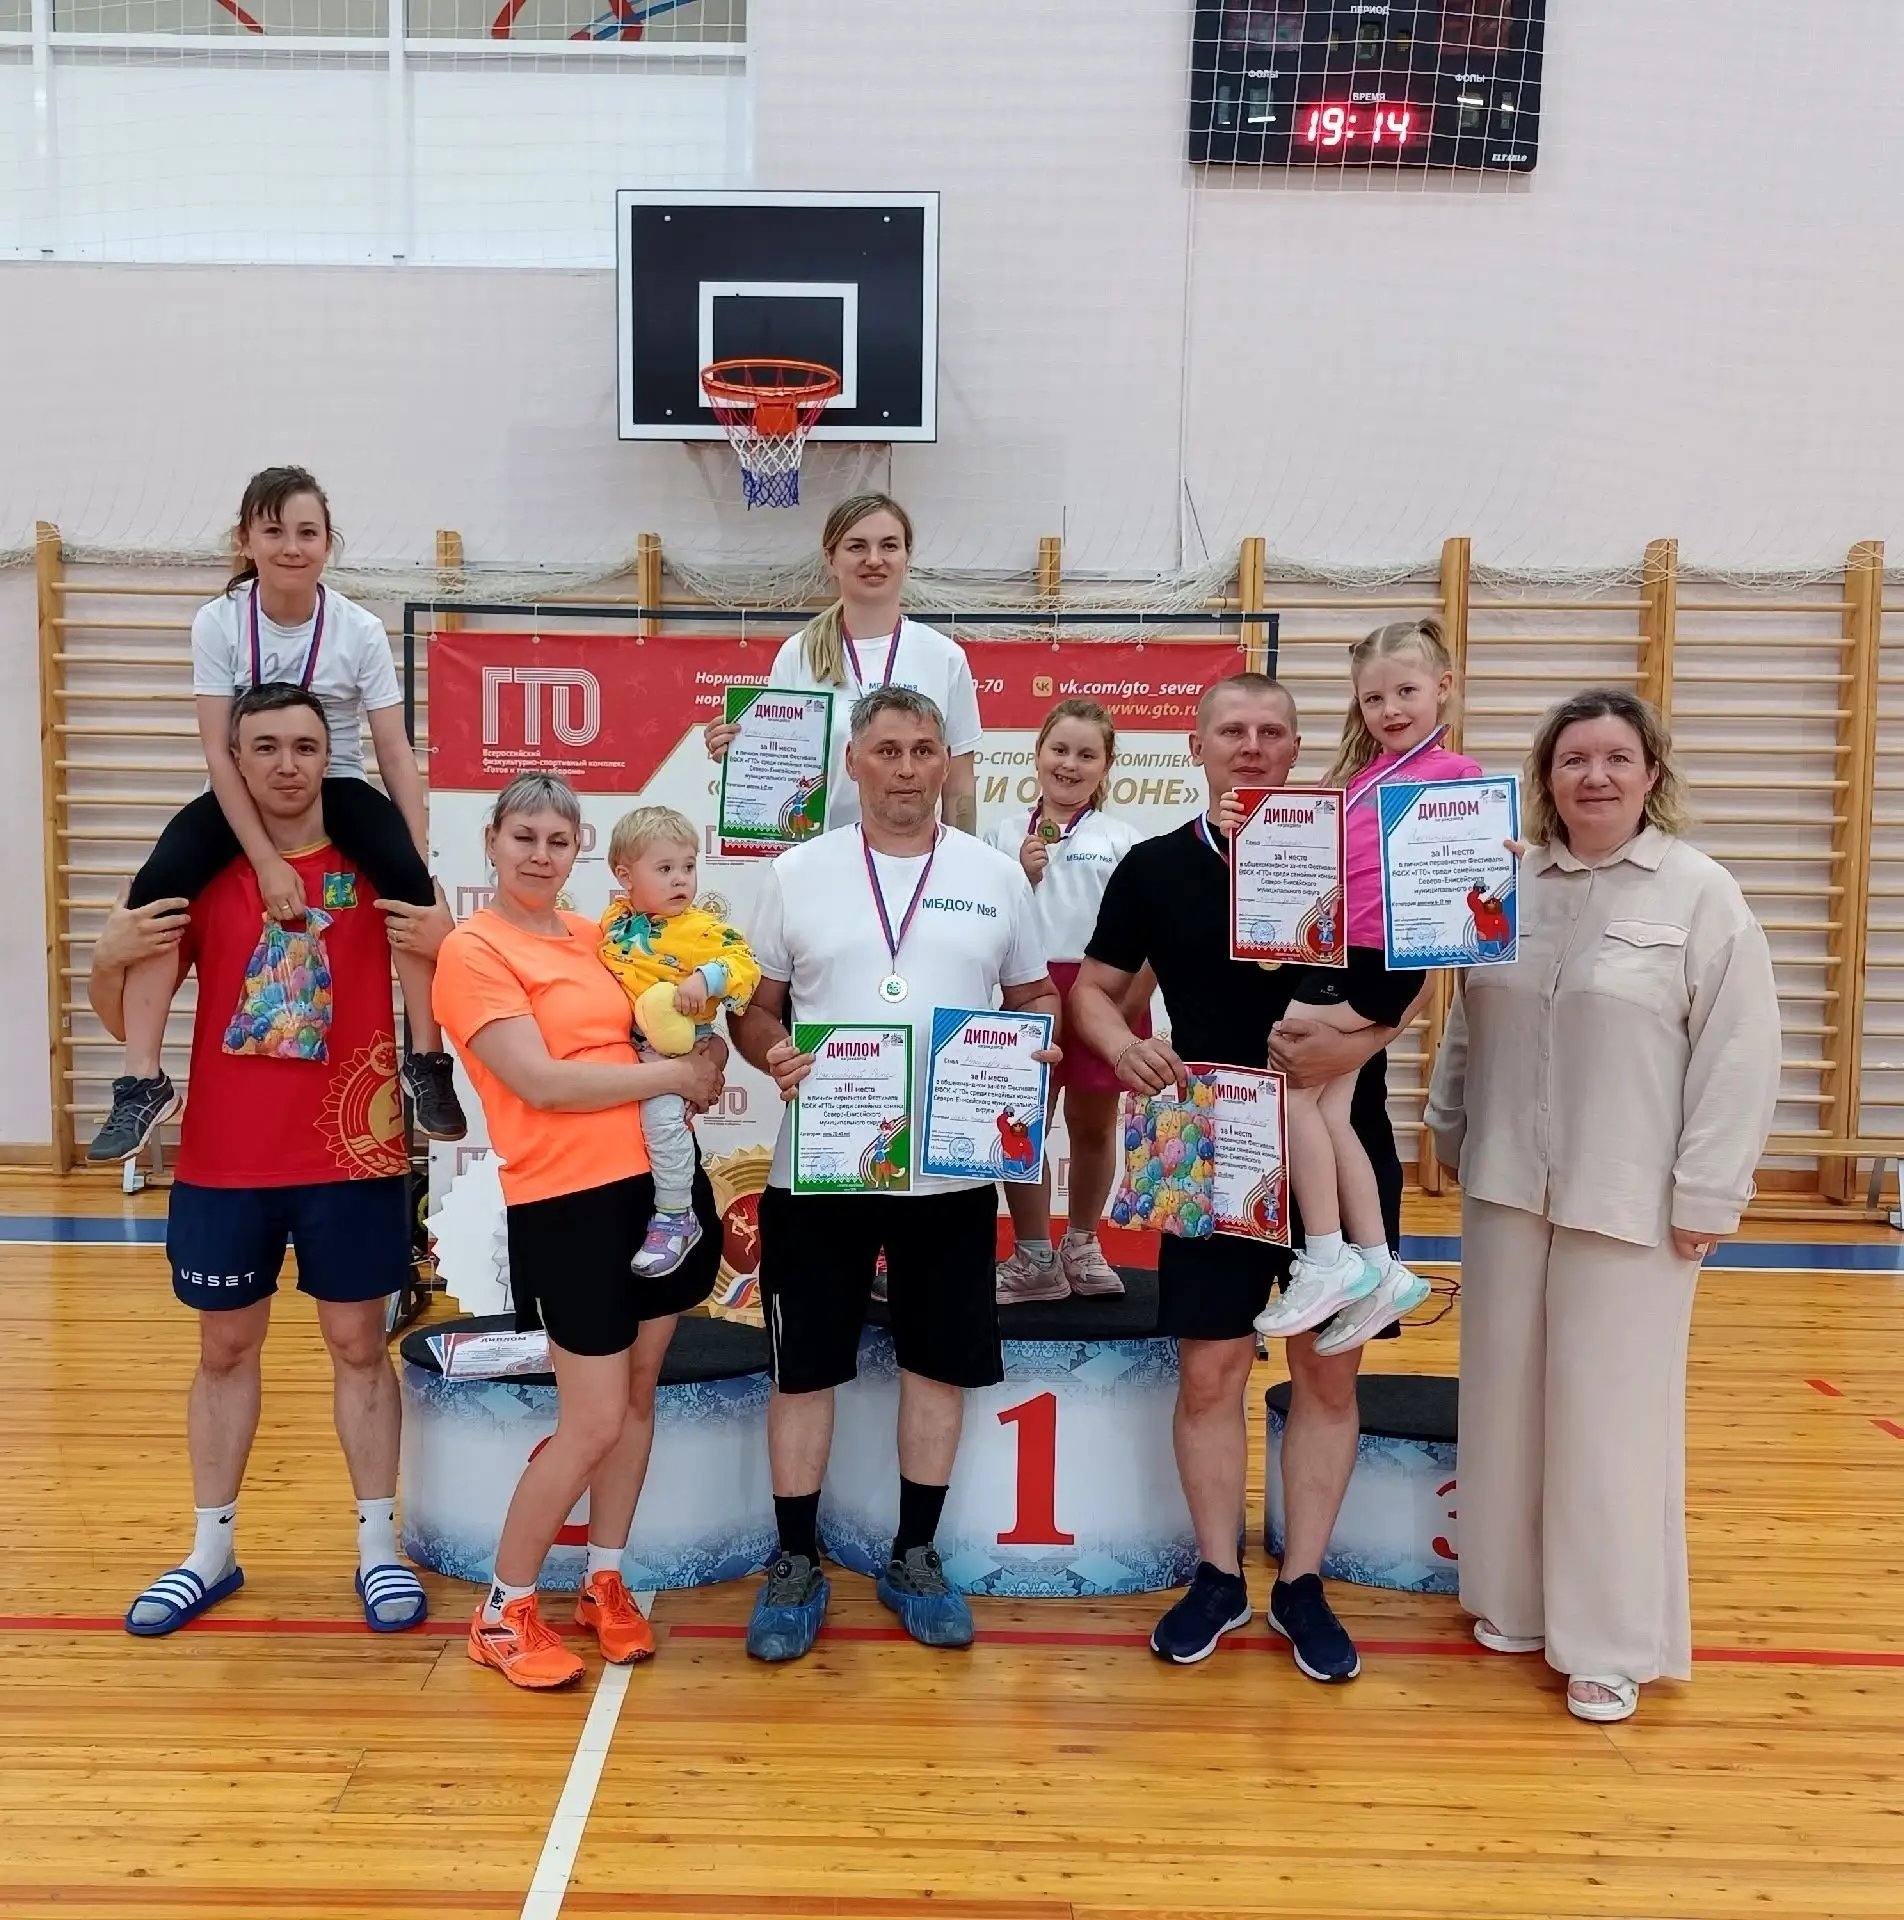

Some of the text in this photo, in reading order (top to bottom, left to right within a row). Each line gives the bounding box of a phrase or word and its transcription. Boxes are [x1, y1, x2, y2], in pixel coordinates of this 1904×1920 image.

[1350, 5, 1390, 16] ПЕРИОД
[1248, 70, 1279, 79] ФОЛЫ
[1455, 73, 1485, 84] ФОЛЫ
[1352, 92, 1386, 102] ВРЕМЯ
[1307, 107, 1411, 146] 19:14
[482, 667, 600, 747] ГТО
[755, 704, 804, 720] ДИПЛОМ
[1107, 703, 1199, 719] www.gto.ru
[983, 776, 1009, 803] И
[1263, 808, 1314, 825] ДИПЛОМ
[1418, 801, 1480, 821] ДИПЛОМ
[1066, 853, 1098, 862] МБДОУ
[457, 886, 497, 916] ГТ
[922, 898, 997, 917] МБДОУ №8
[963, 1029, 1018, 1046] ДИПЛОМ
[826, 1042, 880, 1059] ДИПЛОМ
[997, 1392, 1074, 1545] 1
